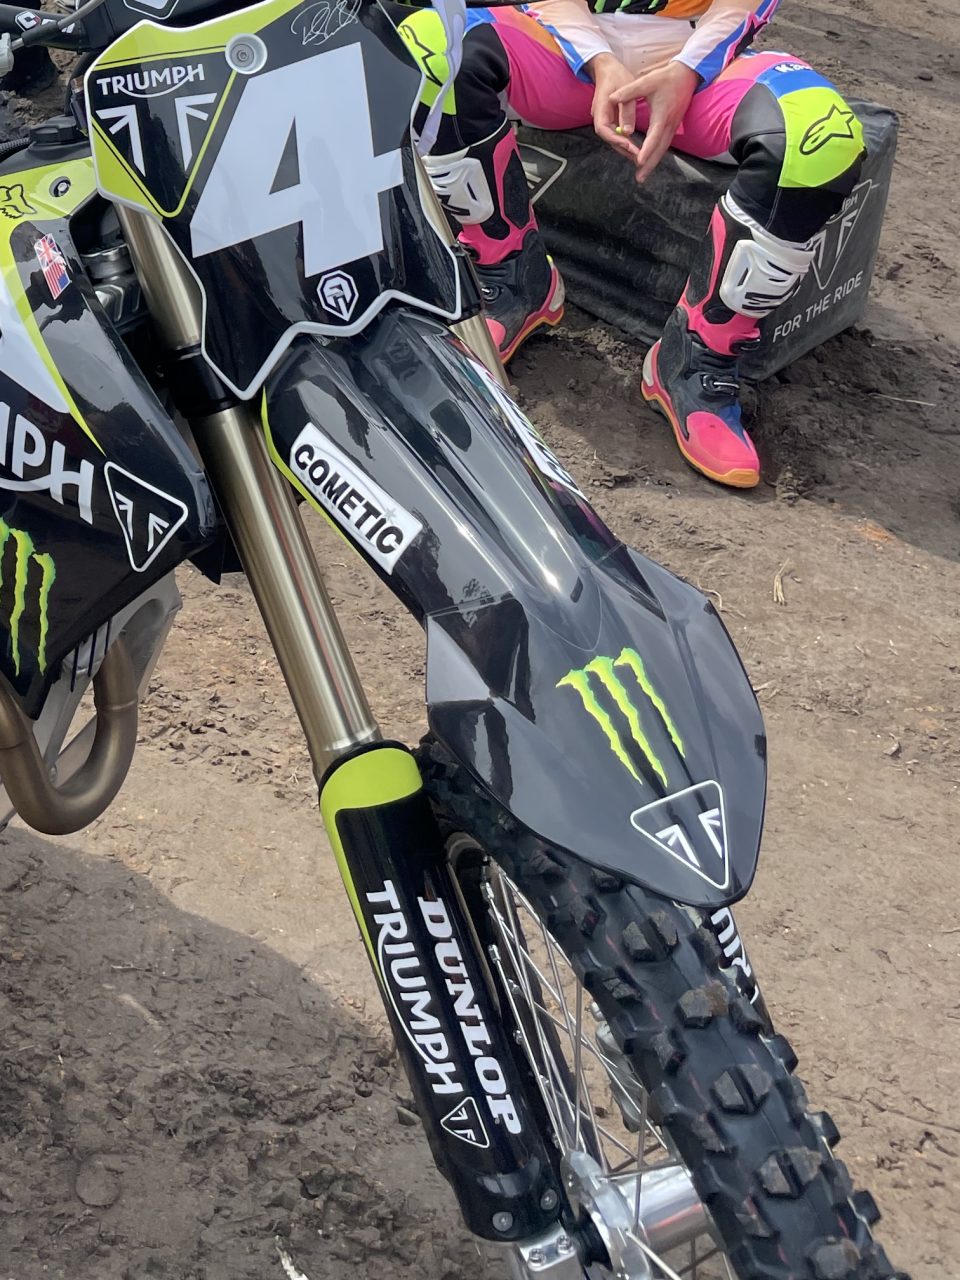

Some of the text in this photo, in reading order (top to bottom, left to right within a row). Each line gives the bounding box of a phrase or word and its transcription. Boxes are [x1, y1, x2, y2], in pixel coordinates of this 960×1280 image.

[96, 63, 205, 98] TRIUMPH
[190, 41, 404, 278] 4
[772, 270, 864, 343] FOR THE RIDE
[295, 443, 404, 555] COMETIC
[366, 880, 462, 1095] TRIUMPH
[418, 896, 522, 1135] DUNLOP
